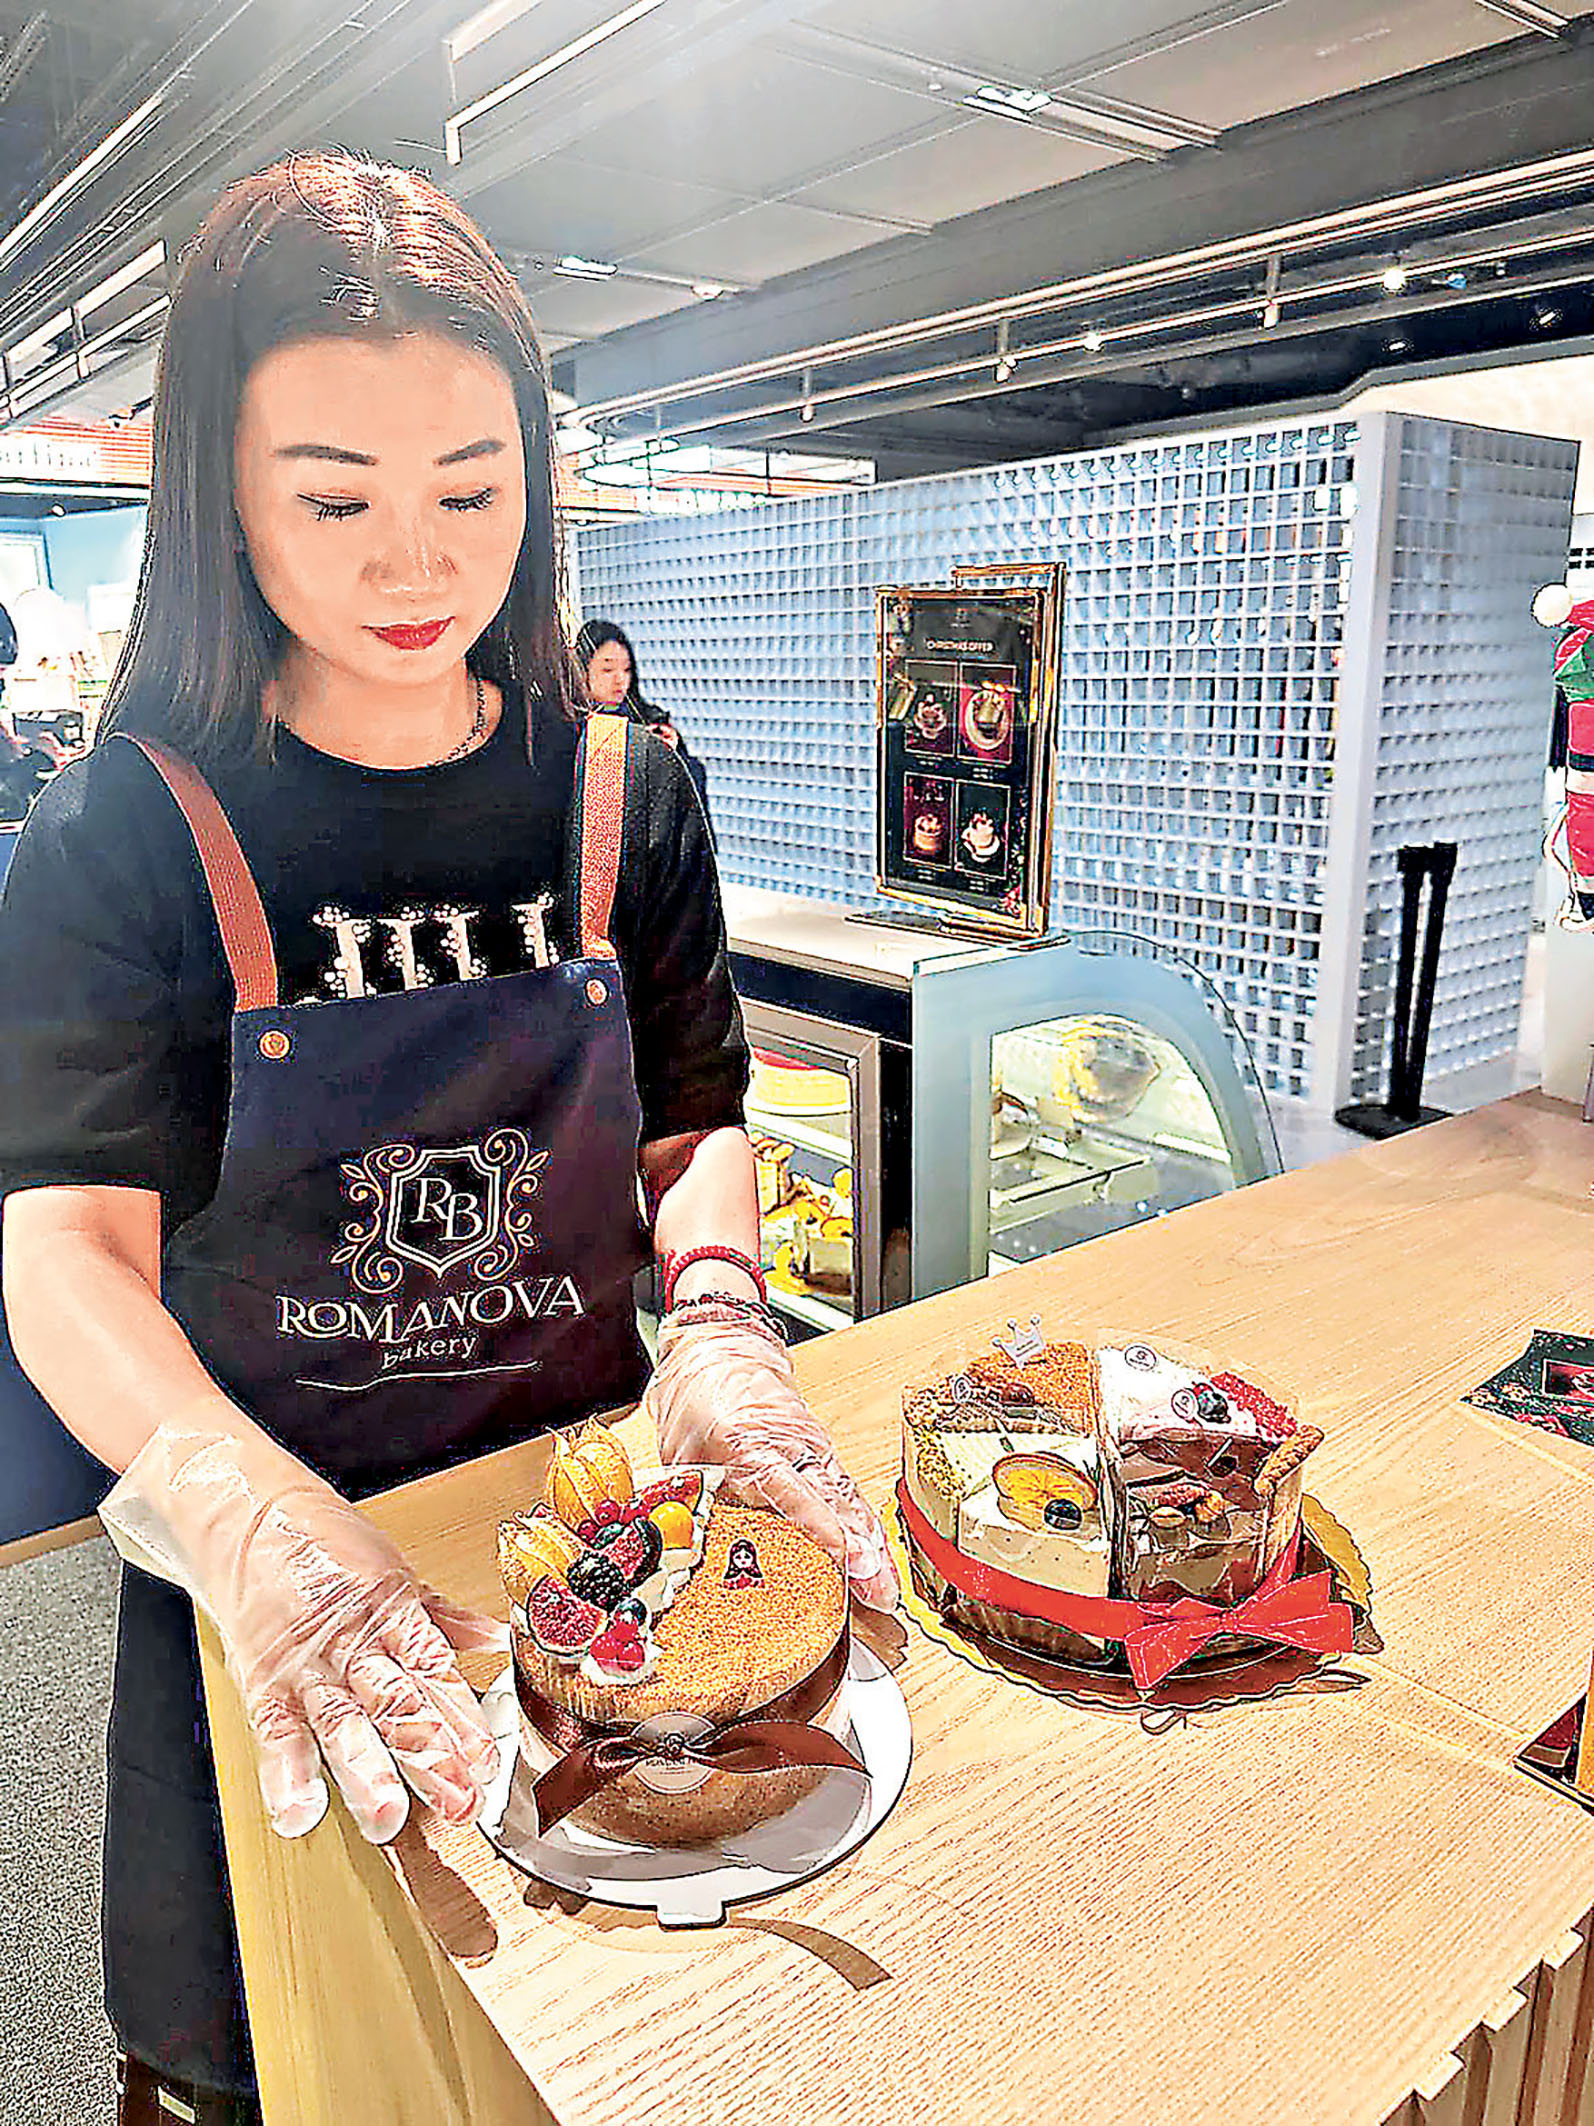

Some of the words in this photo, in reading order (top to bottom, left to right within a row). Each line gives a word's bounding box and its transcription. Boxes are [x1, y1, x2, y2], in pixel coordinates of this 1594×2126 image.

[407, 1176, 484, 1242] RB
[274, 1276, 585, 1343] ROMANOVA
[381, 1335, 478, 1369] bakery
